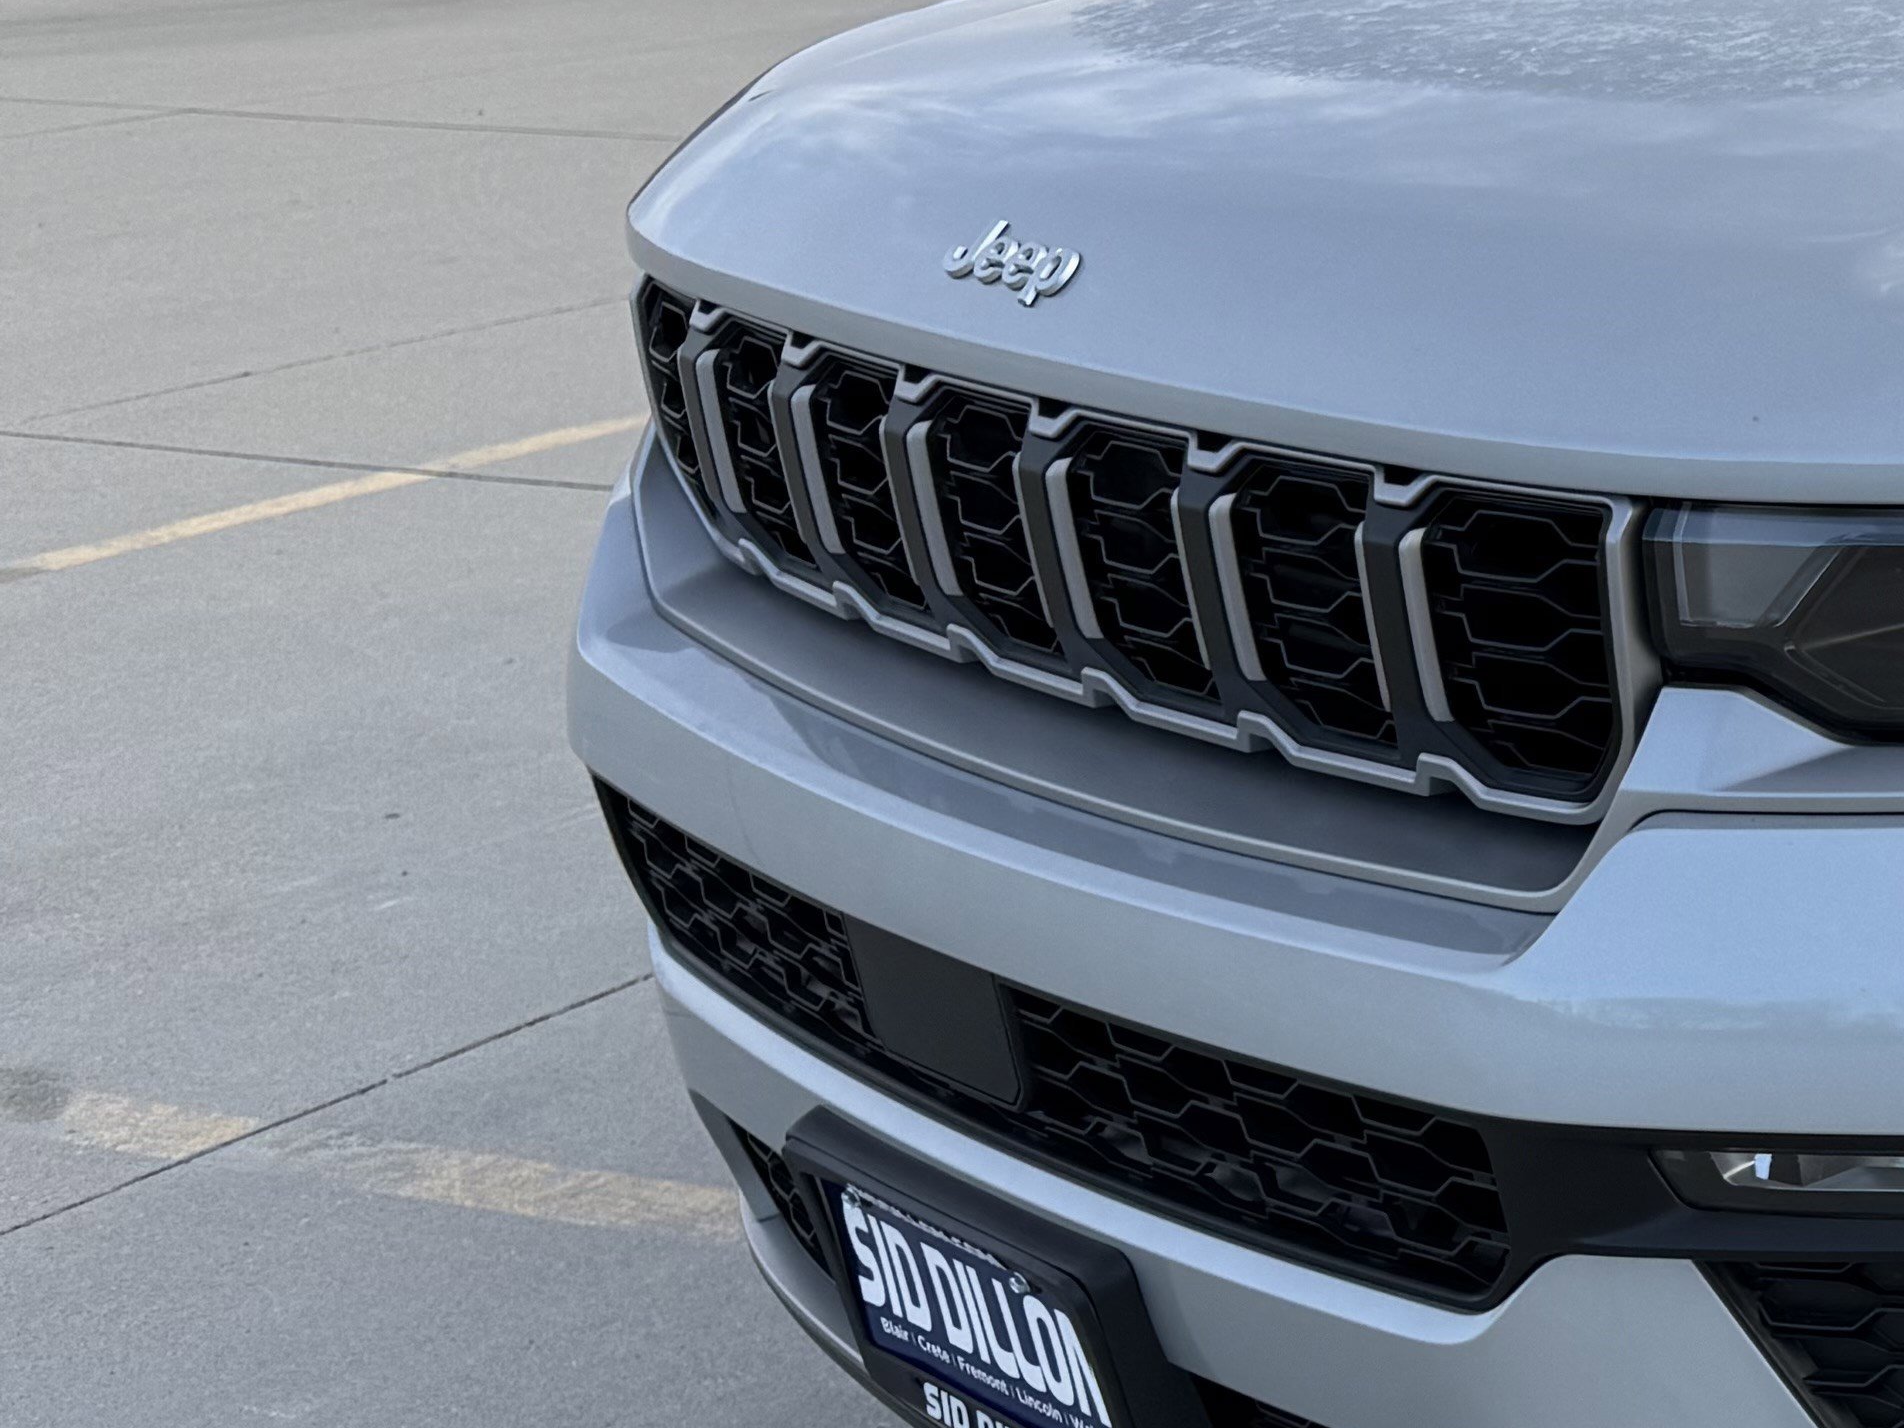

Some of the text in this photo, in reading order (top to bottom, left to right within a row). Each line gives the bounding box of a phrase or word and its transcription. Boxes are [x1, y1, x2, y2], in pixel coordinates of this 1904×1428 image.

[943, 220, 1081, 307] Jeep
[842, 1192, 1112, 1428] SID DILLON
[917, 1335, 951, 1364] Crete
[958, 1355, 1009, 1396] Fremont
[1015, 1387, 1064, 1423] Lincoln
